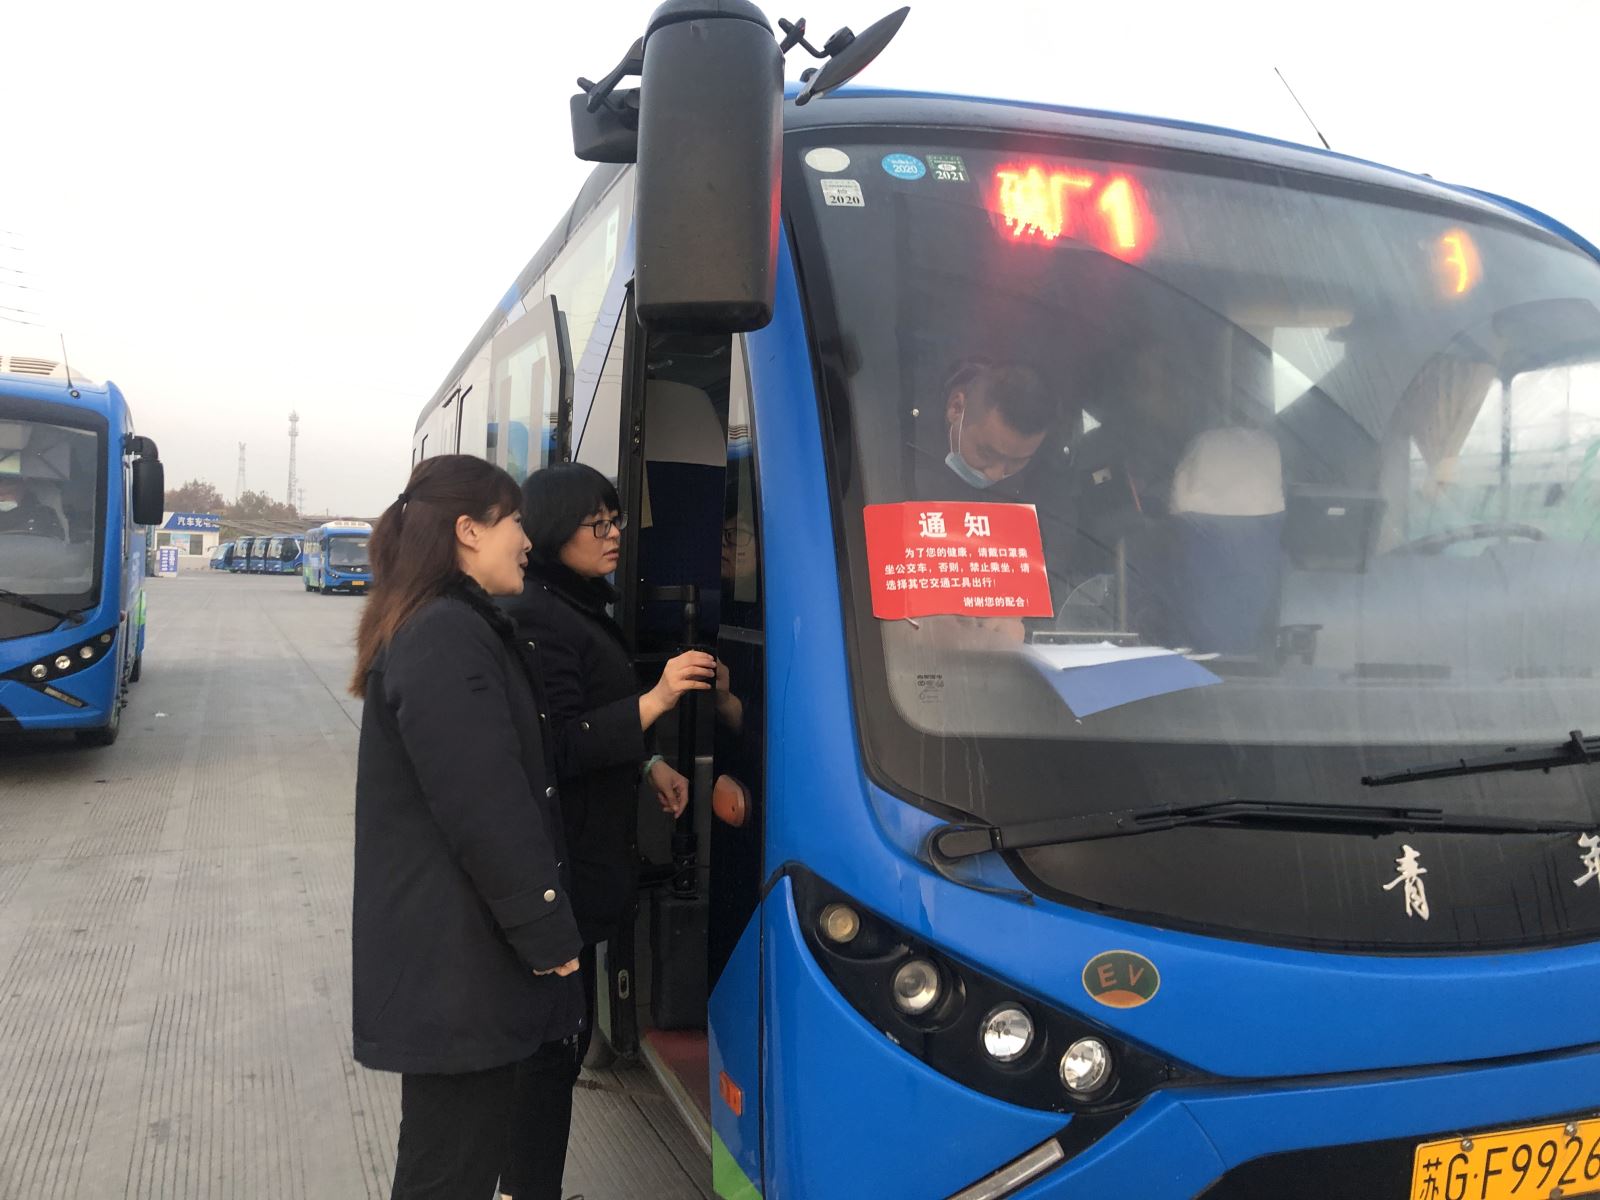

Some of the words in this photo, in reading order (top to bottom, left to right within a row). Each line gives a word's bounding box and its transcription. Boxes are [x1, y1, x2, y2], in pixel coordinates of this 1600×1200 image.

[893, 164, 918, 174] 2020
[935, 171, 965, 181] 2021
[829, 195, 861, 205] 2020
[918, 512, 991, 538] 通知
[1097, 963, 1145, 988] EV
